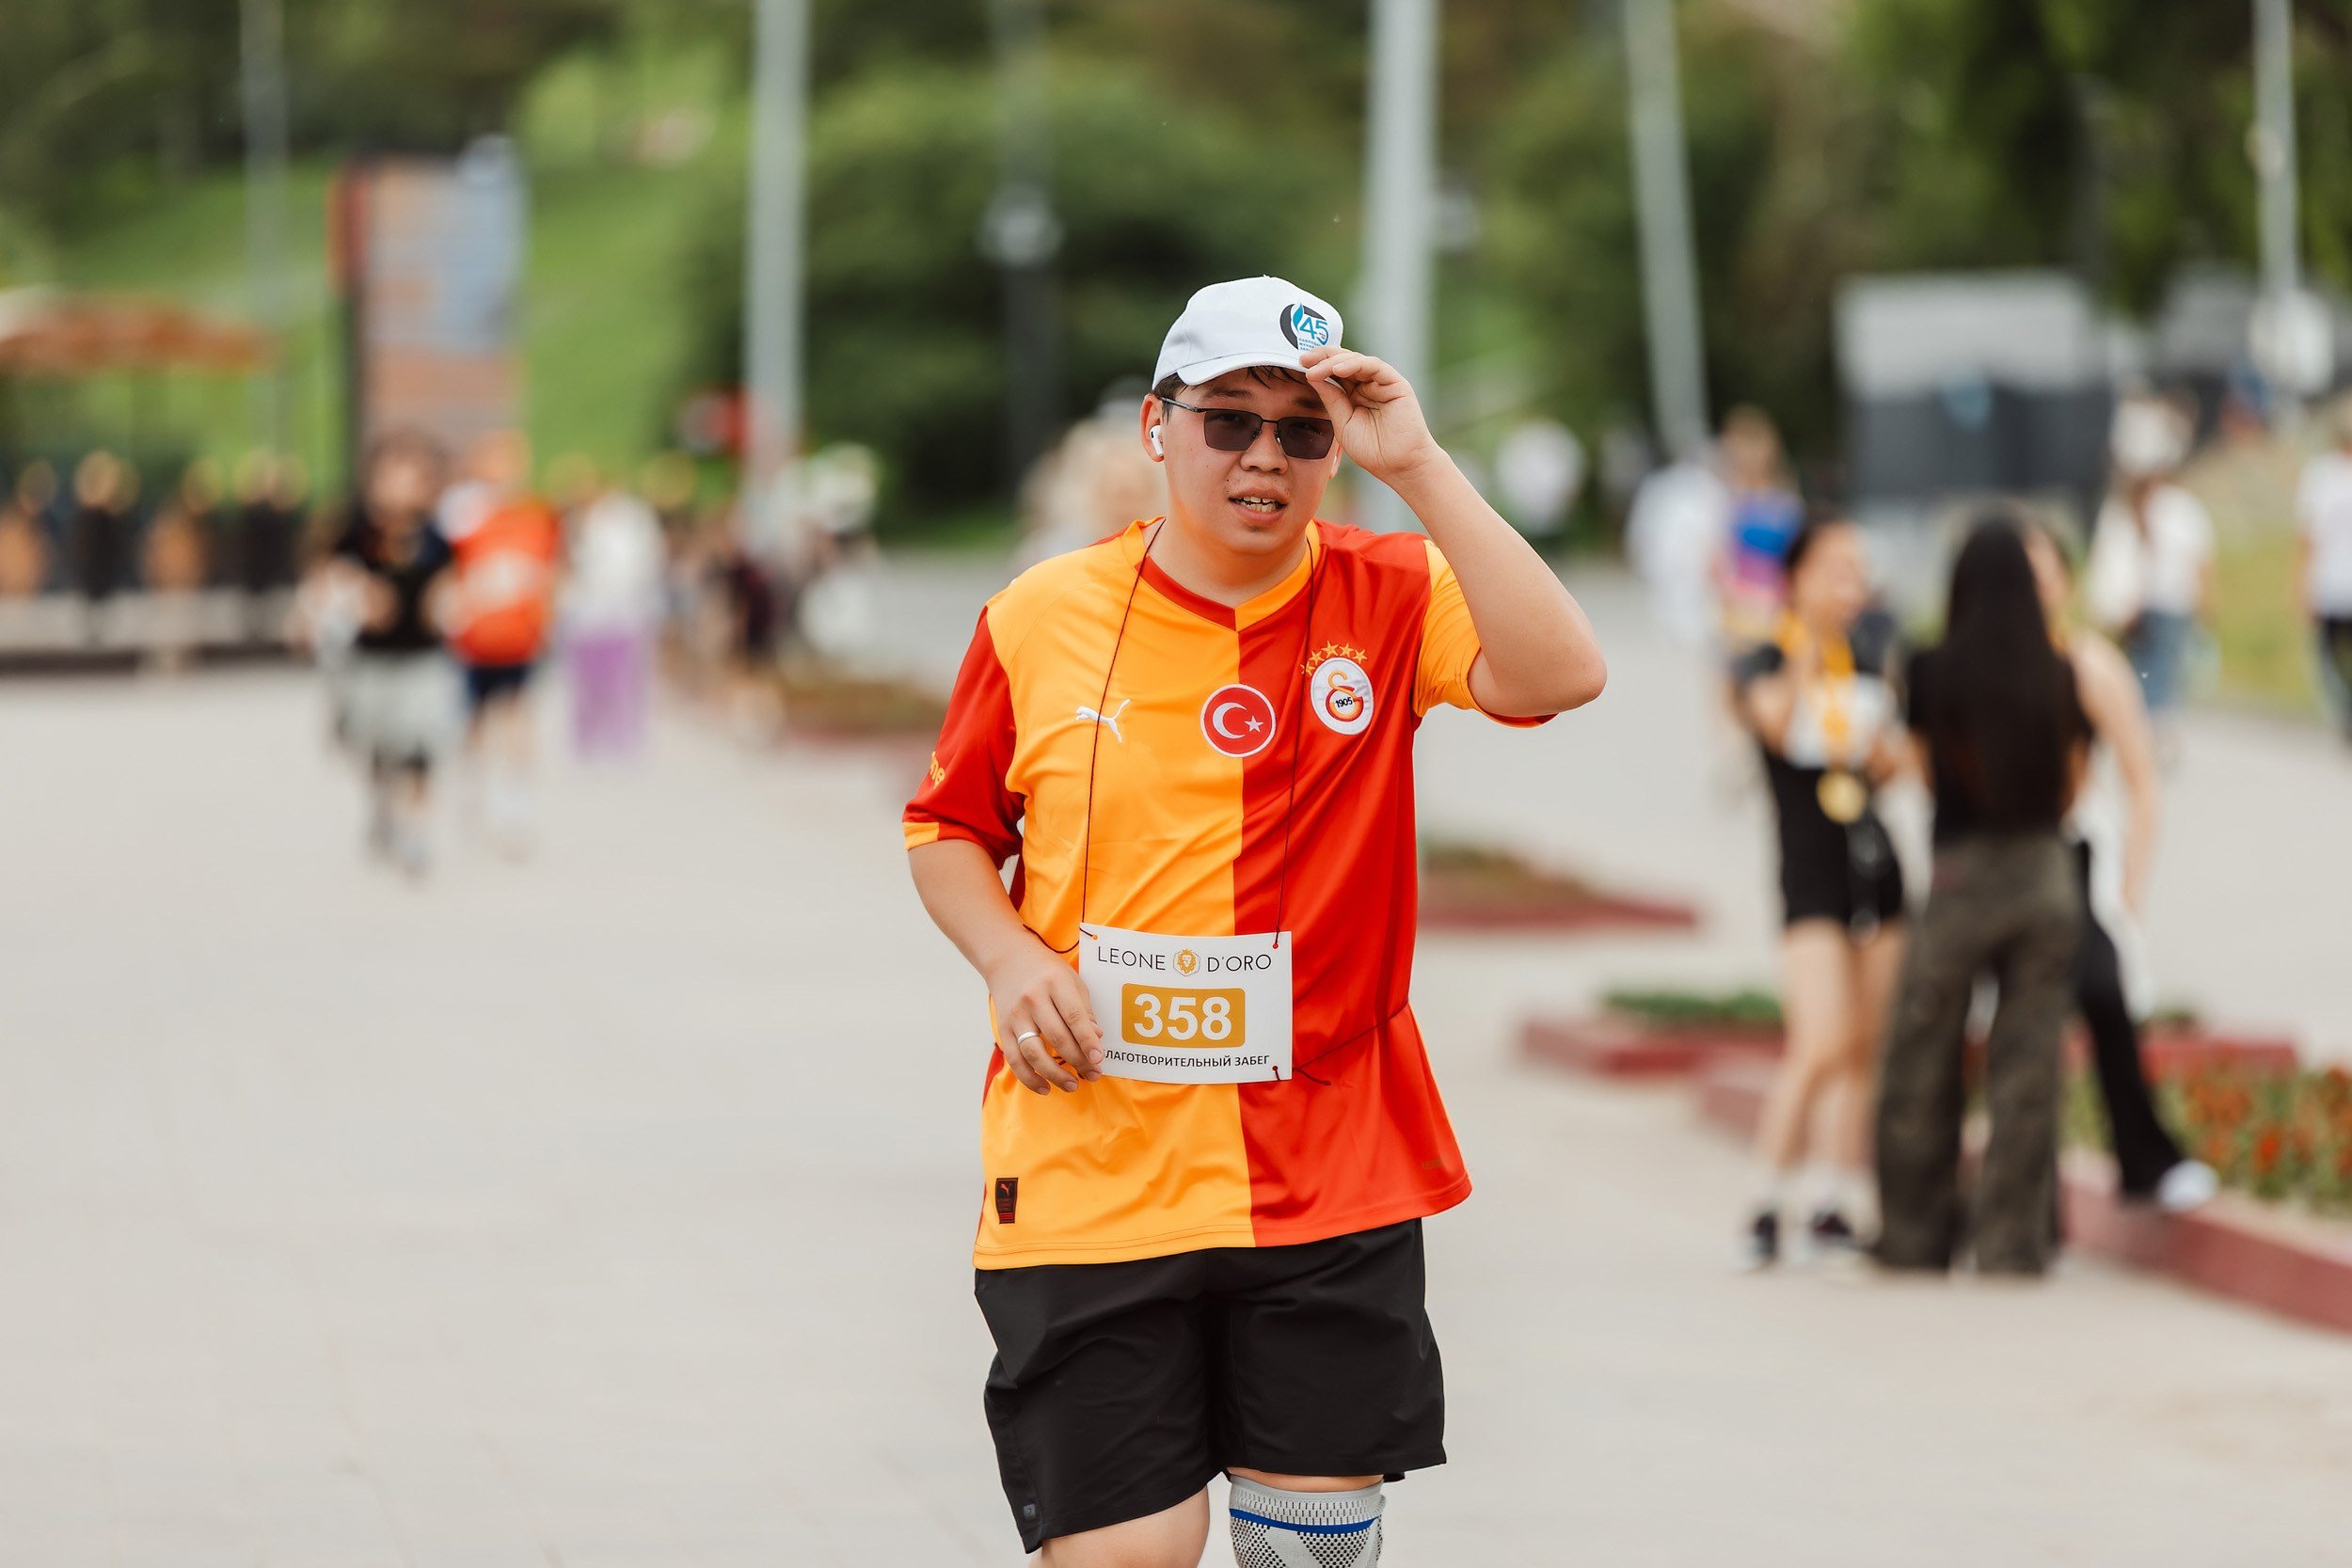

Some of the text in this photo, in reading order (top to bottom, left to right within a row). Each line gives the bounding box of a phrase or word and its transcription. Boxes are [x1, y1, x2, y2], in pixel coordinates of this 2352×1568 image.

[1299, 317, 1328, 345] 45
[1336, 697, 1353, 707] 1905
[1098, 946, 1272, 973] LEONE D'ORO
[1134, 993, 1232, 1040] 358
[1104, 1050, 1270, 1067] ЛАГОТВОРИТЕЛЬНЫЙ ЗАБЕГ
